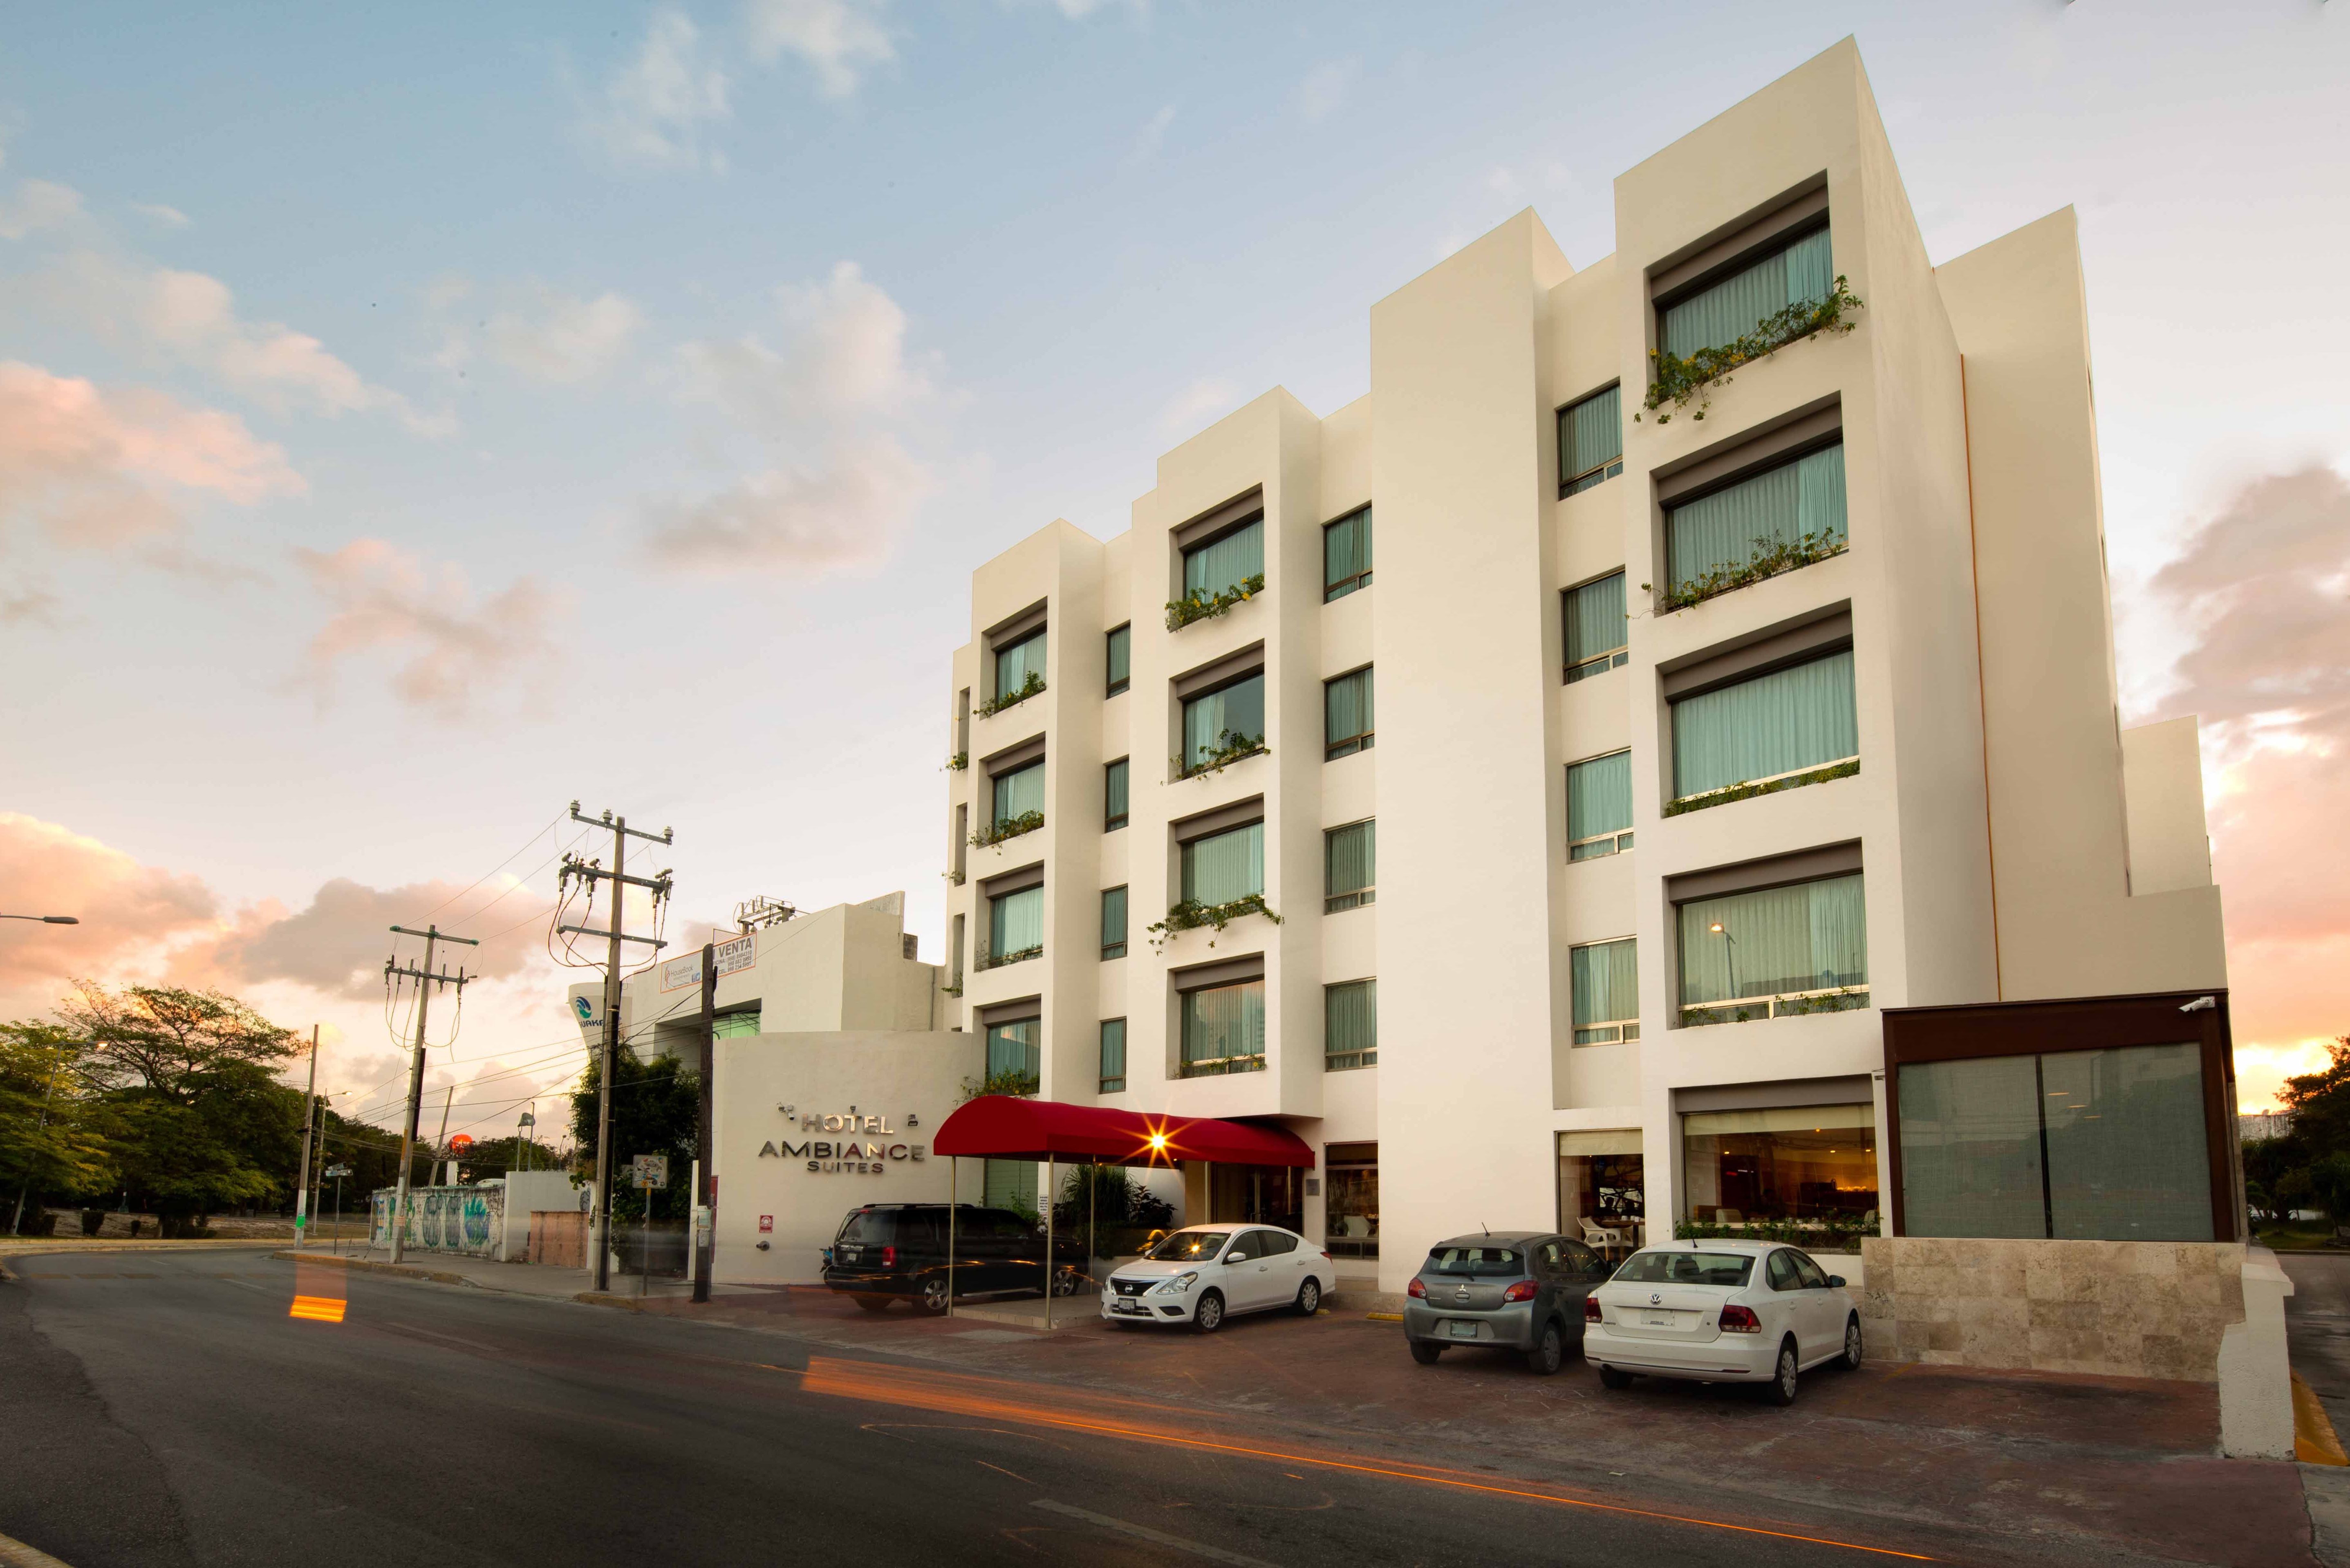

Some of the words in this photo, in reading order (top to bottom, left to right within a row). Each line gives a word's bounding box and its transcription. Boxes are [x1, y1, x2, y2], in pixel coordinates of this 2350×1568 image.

[719, 938, 752, 958] VENTA
[802, 1113, 894, 1134] HOTEL
[758, 1140, 925, 1161] AMBIANCE
[806, 1160, 884, 1173] SUITES
